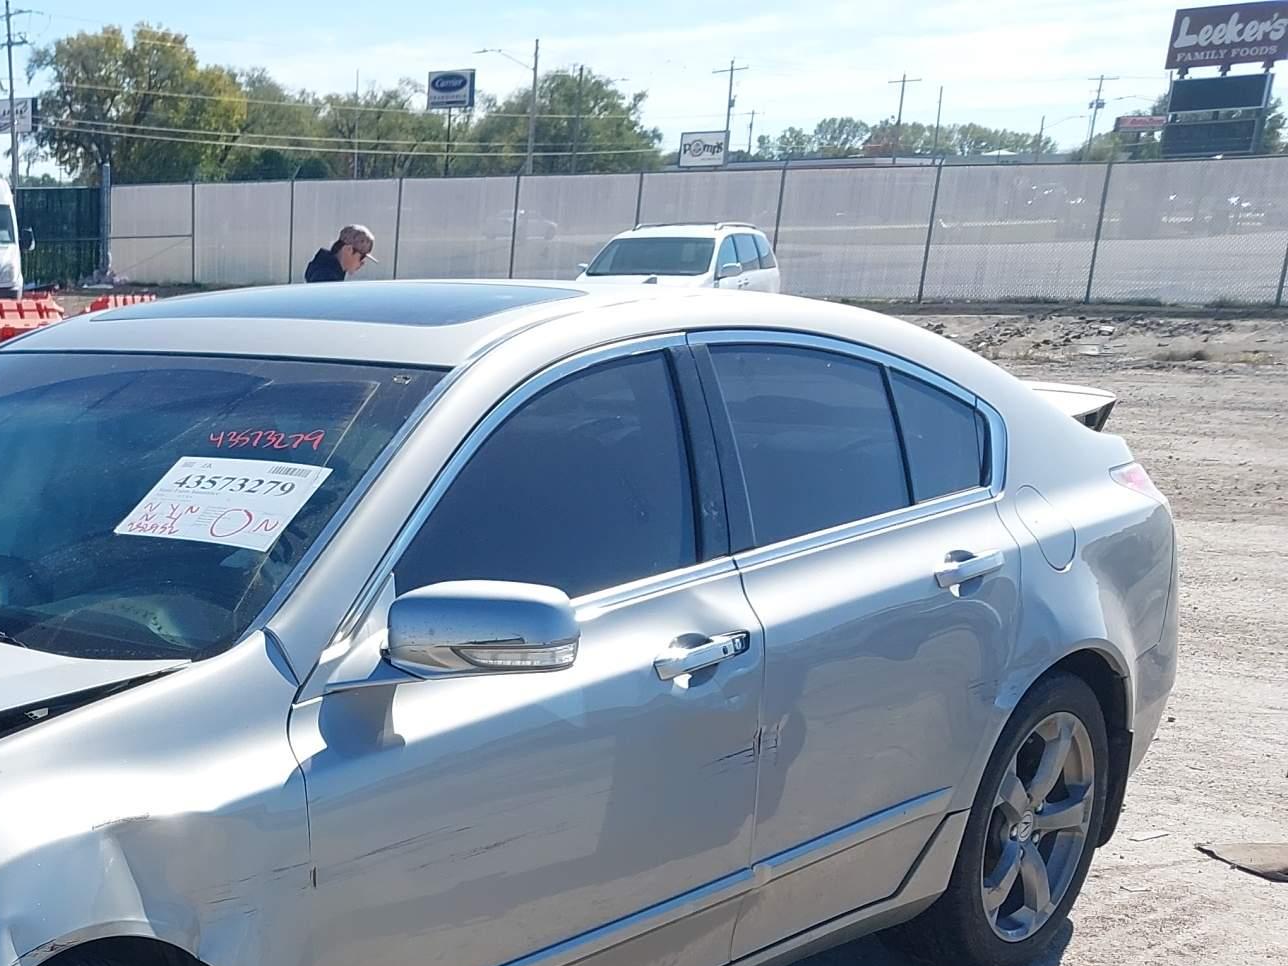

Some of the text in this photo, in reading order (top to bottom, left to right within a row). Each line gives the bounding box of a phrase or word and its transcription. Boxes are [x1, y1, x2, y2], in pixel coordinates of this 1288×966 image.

[1173, 12, 1288, 48] Leeker's
[1176, 45, 1278, 62] FAMILY FOODS
[209, 429, 325, 451] 43573279
[174, 474, 296, 497] 43573279
